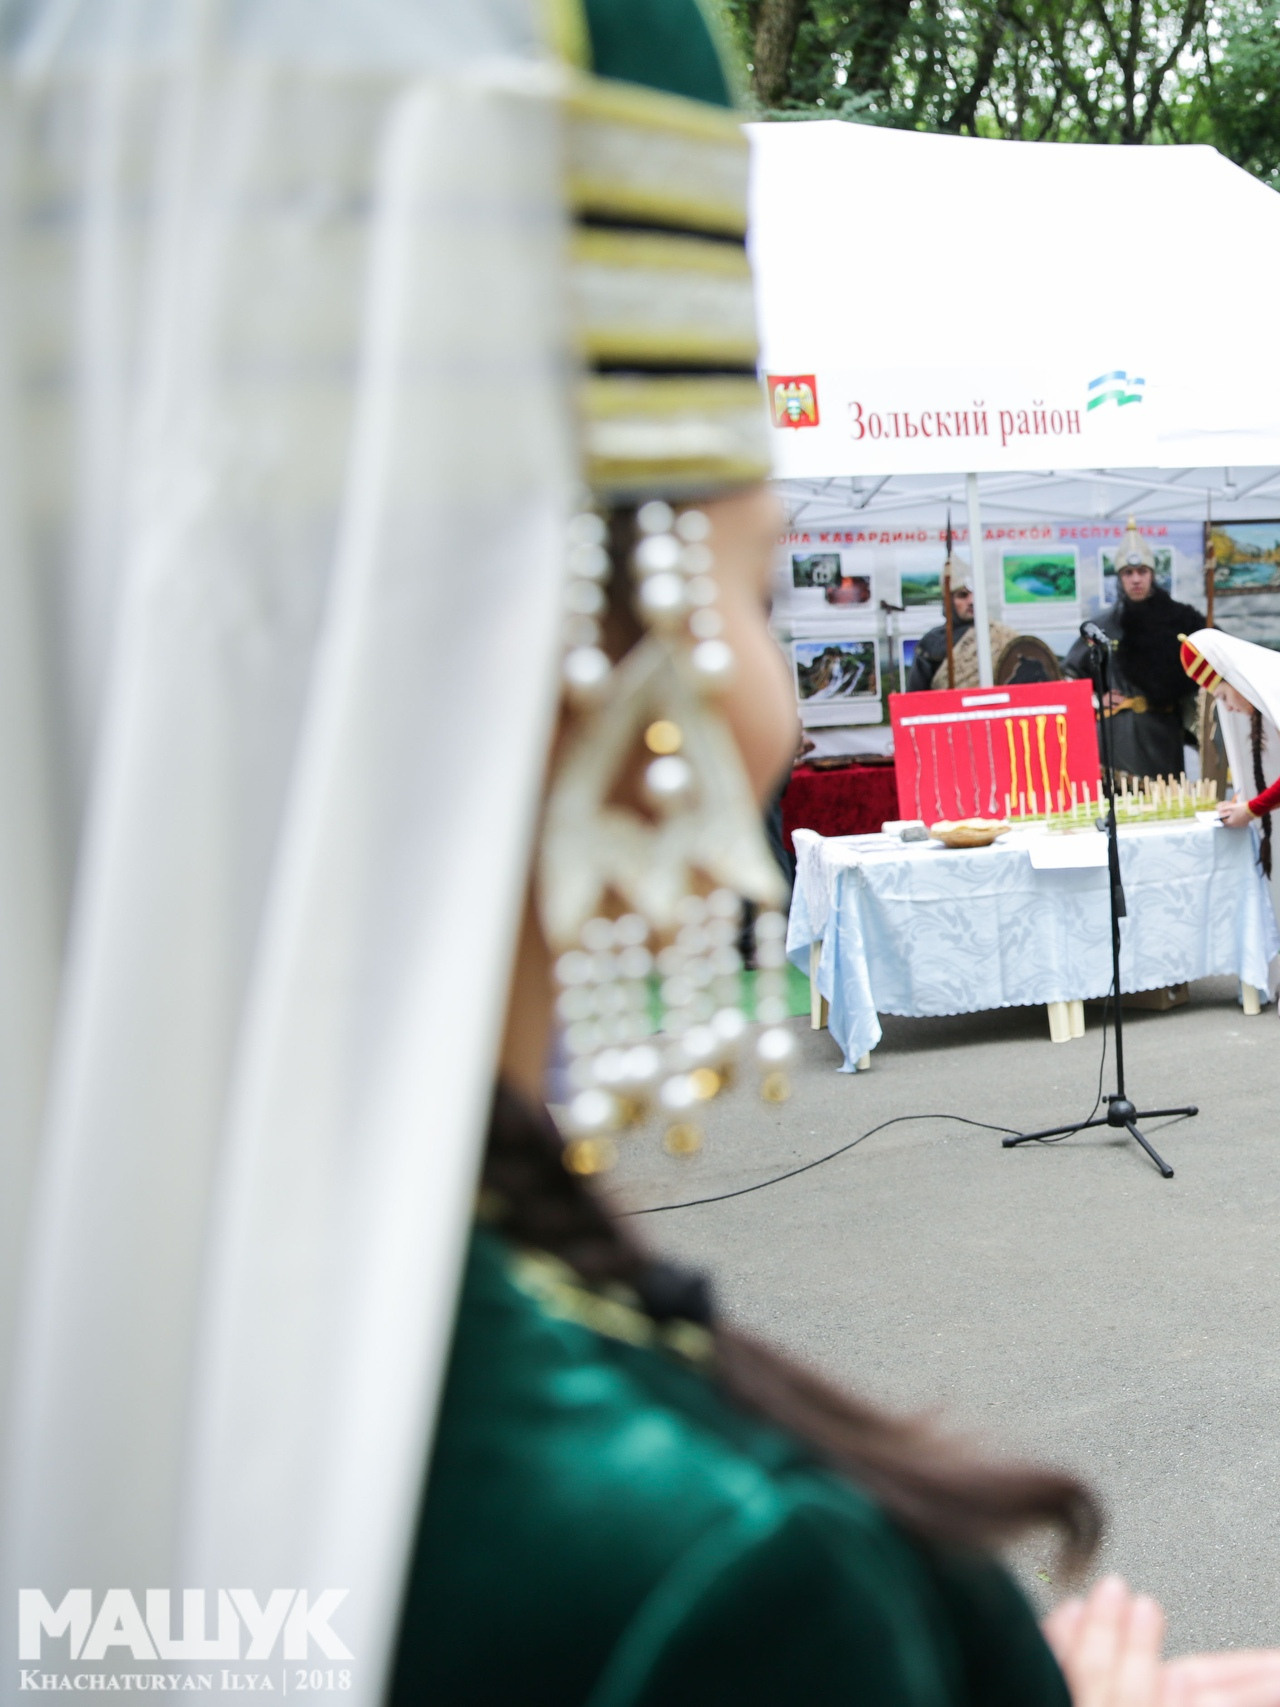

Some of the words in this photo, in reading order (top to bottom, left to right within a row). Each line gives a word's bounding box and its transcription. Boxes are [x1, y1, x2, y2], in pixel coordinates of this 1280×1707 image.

[848, 399, 989, 440] Зольский
[999, 399, 1082, 447] район
[819, 524, 1052, 543] КАБАРДИНО-БАЛАРСКОЙ
[1059, 525, 1169, 539] РЕСПУБИКИ
